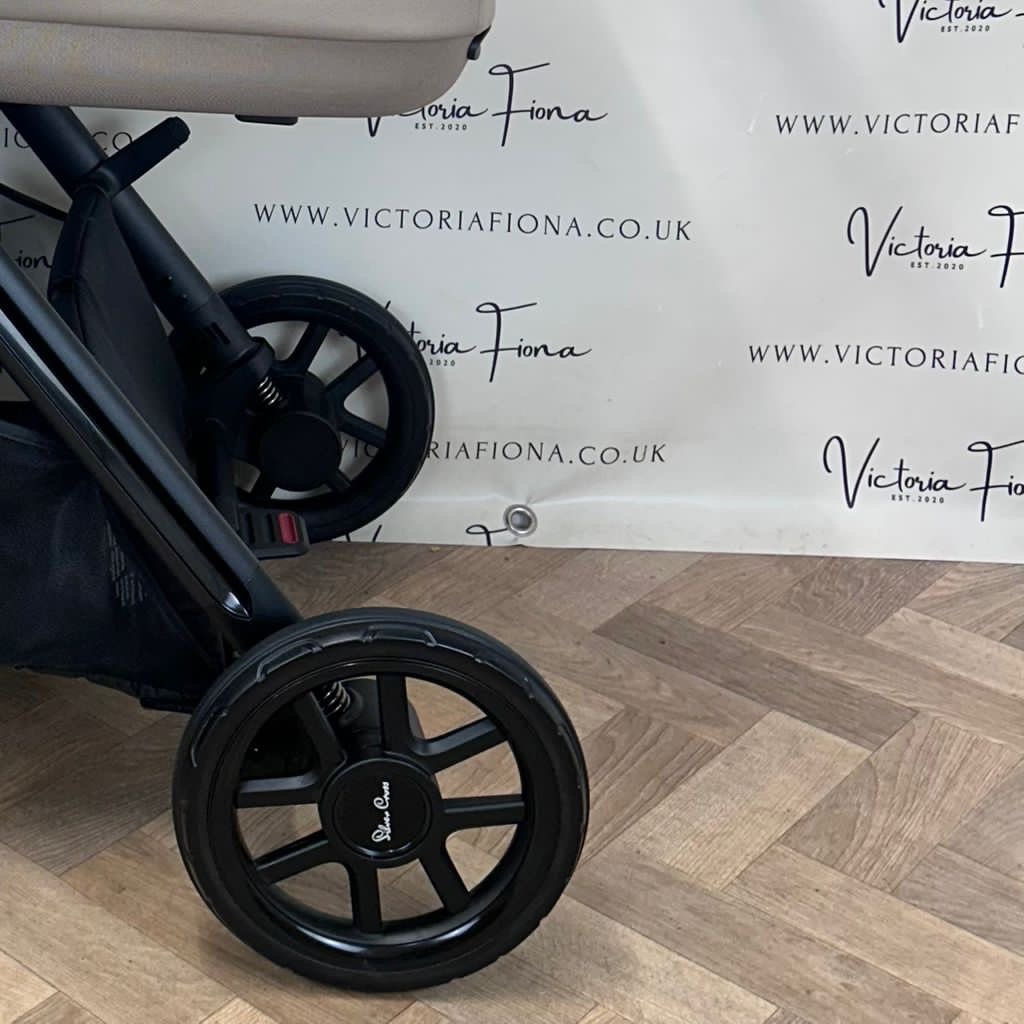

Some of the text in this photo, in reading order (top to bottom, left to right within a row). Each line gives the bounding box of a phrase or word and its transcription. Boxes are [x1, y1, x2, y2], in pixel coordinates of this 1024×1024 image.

[488, 62, 608, 147] Fiona
[776, 113, 1020, 135] WWW.VICTORIAF
[254, 204, 691, 240] WWW.VICTORIAFIONA.CO.UK
[847, 206, 987, 277] Victoria
[475, 302, 592, 383] Fiona
[823, 436, 967, 509] Victoria
